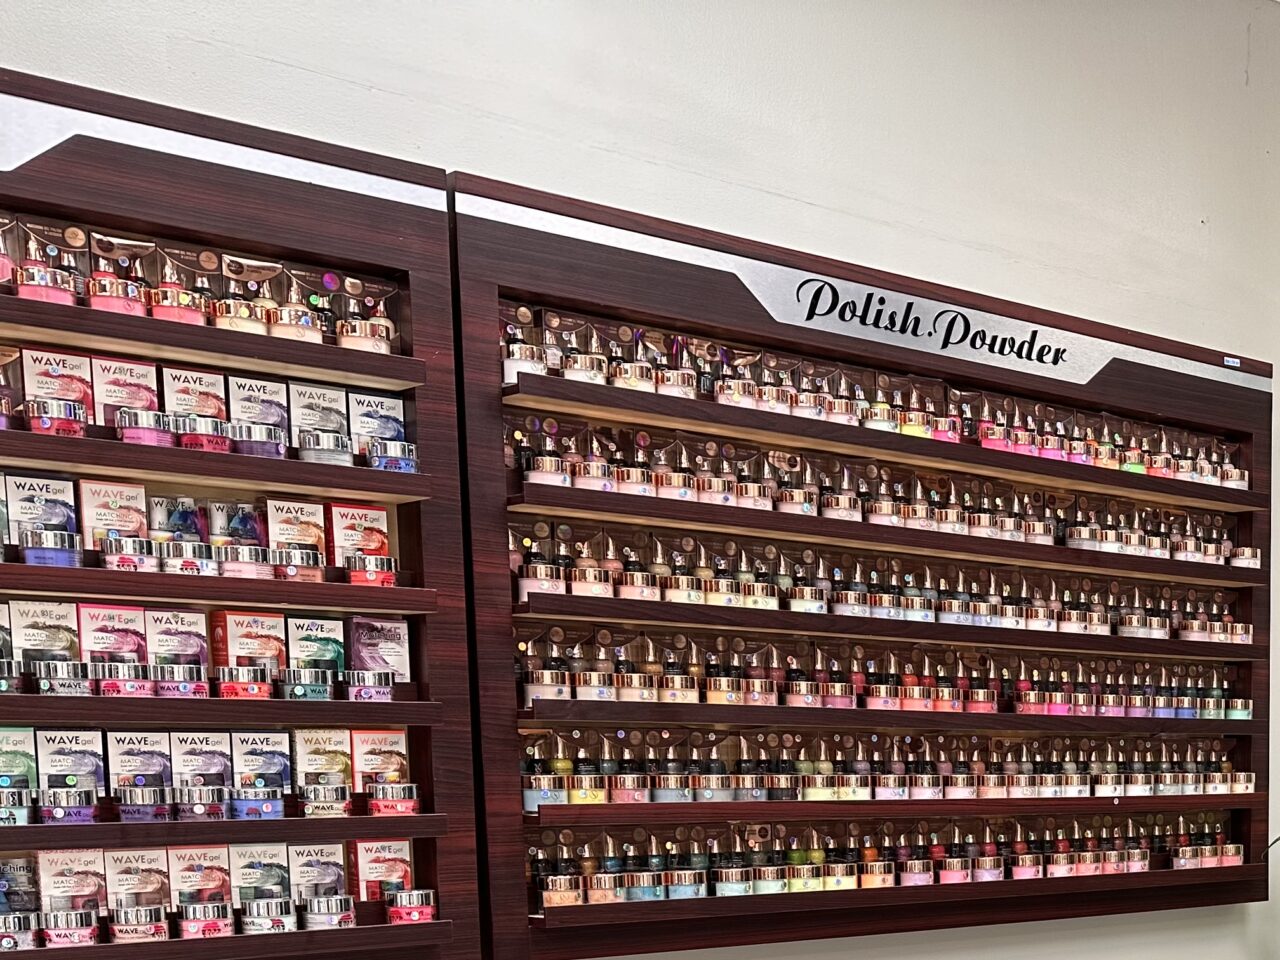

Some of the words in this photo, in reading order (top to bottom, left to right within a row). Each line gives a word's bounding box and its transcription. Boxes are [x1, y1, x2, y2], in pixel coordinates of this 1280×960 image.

[797, 278, 925, 338] Polish
[933, 308, 1067, 366] Powder
[31, 354, 67, 369] WAVE
[170, 373, 203, 386] WAVE
[236, 382, 268, 395] WAVE
[296, 389, 327, 402] WAVE
[355, 398, 385, 410] WAVE
[14, 481, 51, 494] WAVE
[90, 488, 125, 500] WAVE
[153, 500, 186, 510] WAVE
[214, 504, 246, 514] WAVE
[274, 505, 305, 516] WAVE
[339, 512, 369, 522] WAVE
[18, 608, 54, 619] WAE
[88, 612, 123, 623] WAE
[234, 619, 265, 629] WAE
[45, 735, 80, 745] WAVE
[115, 736, 148, 746] WAVE
[178, 736, 210, 746] WAVE
[239, 737, 270, 746] WAVE
[303, 737, 333, 746] WAVE
[359, 737, 388, 746] WAVE
[176, 853, 208, 862] WAVE
[236, 850, 268, 860] WAVE
[295, 849, 324, 858] WAVE
[112, 855, 146, 864] WAVE
